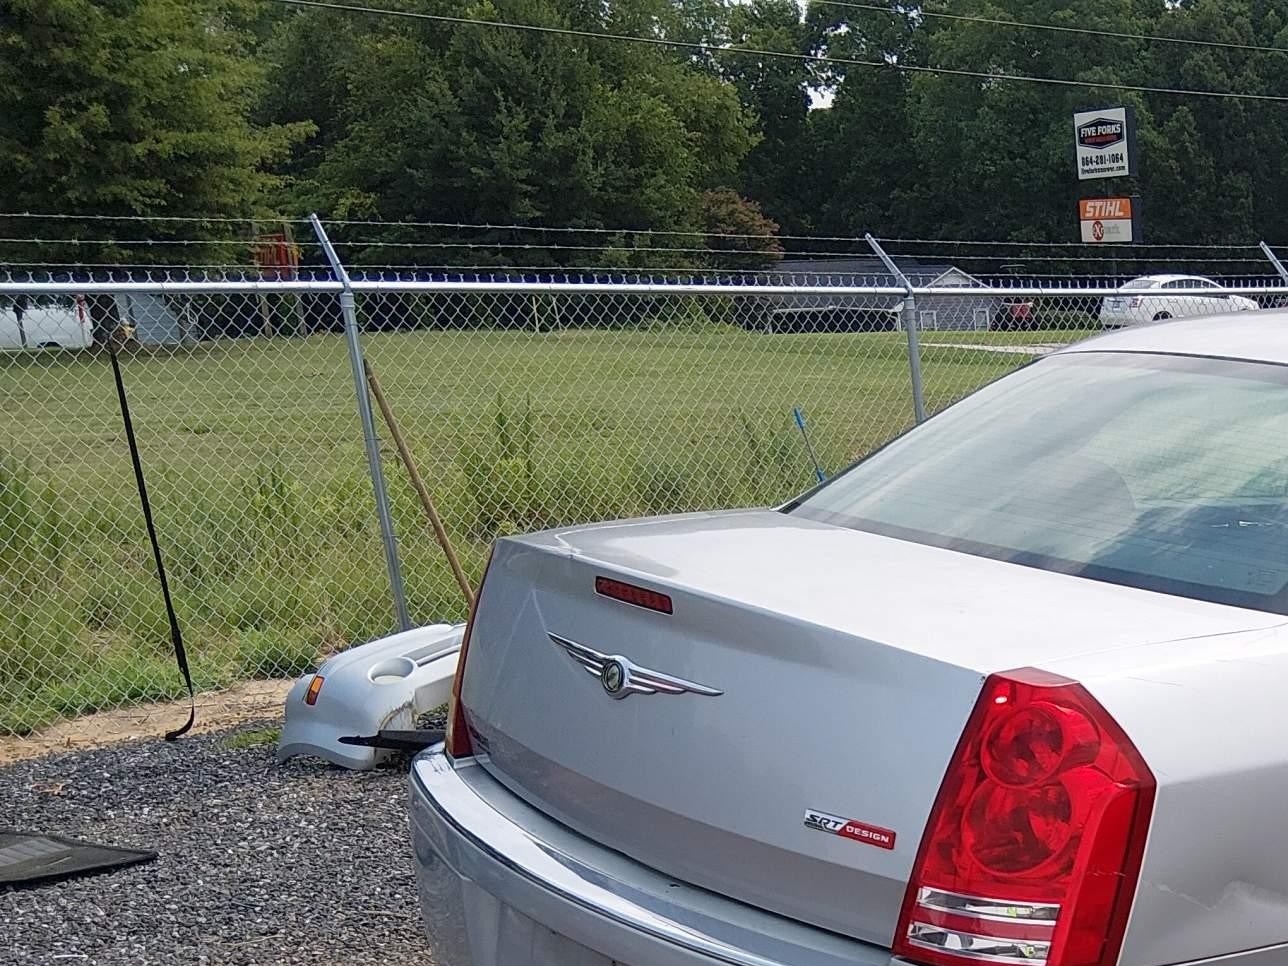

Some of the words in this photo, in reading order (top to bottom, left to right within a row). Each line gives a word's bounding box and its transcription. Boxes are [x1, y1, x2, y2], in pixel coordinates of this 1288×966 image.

[1081, 126, 1097, 138] FIVE
[1097, 123, 1121, 136] FORKS
[1085, 200, 1124, 217] STIHL
[806, 814, 843, 830] SRT
[845, 825, 890, 843] DESIGN
